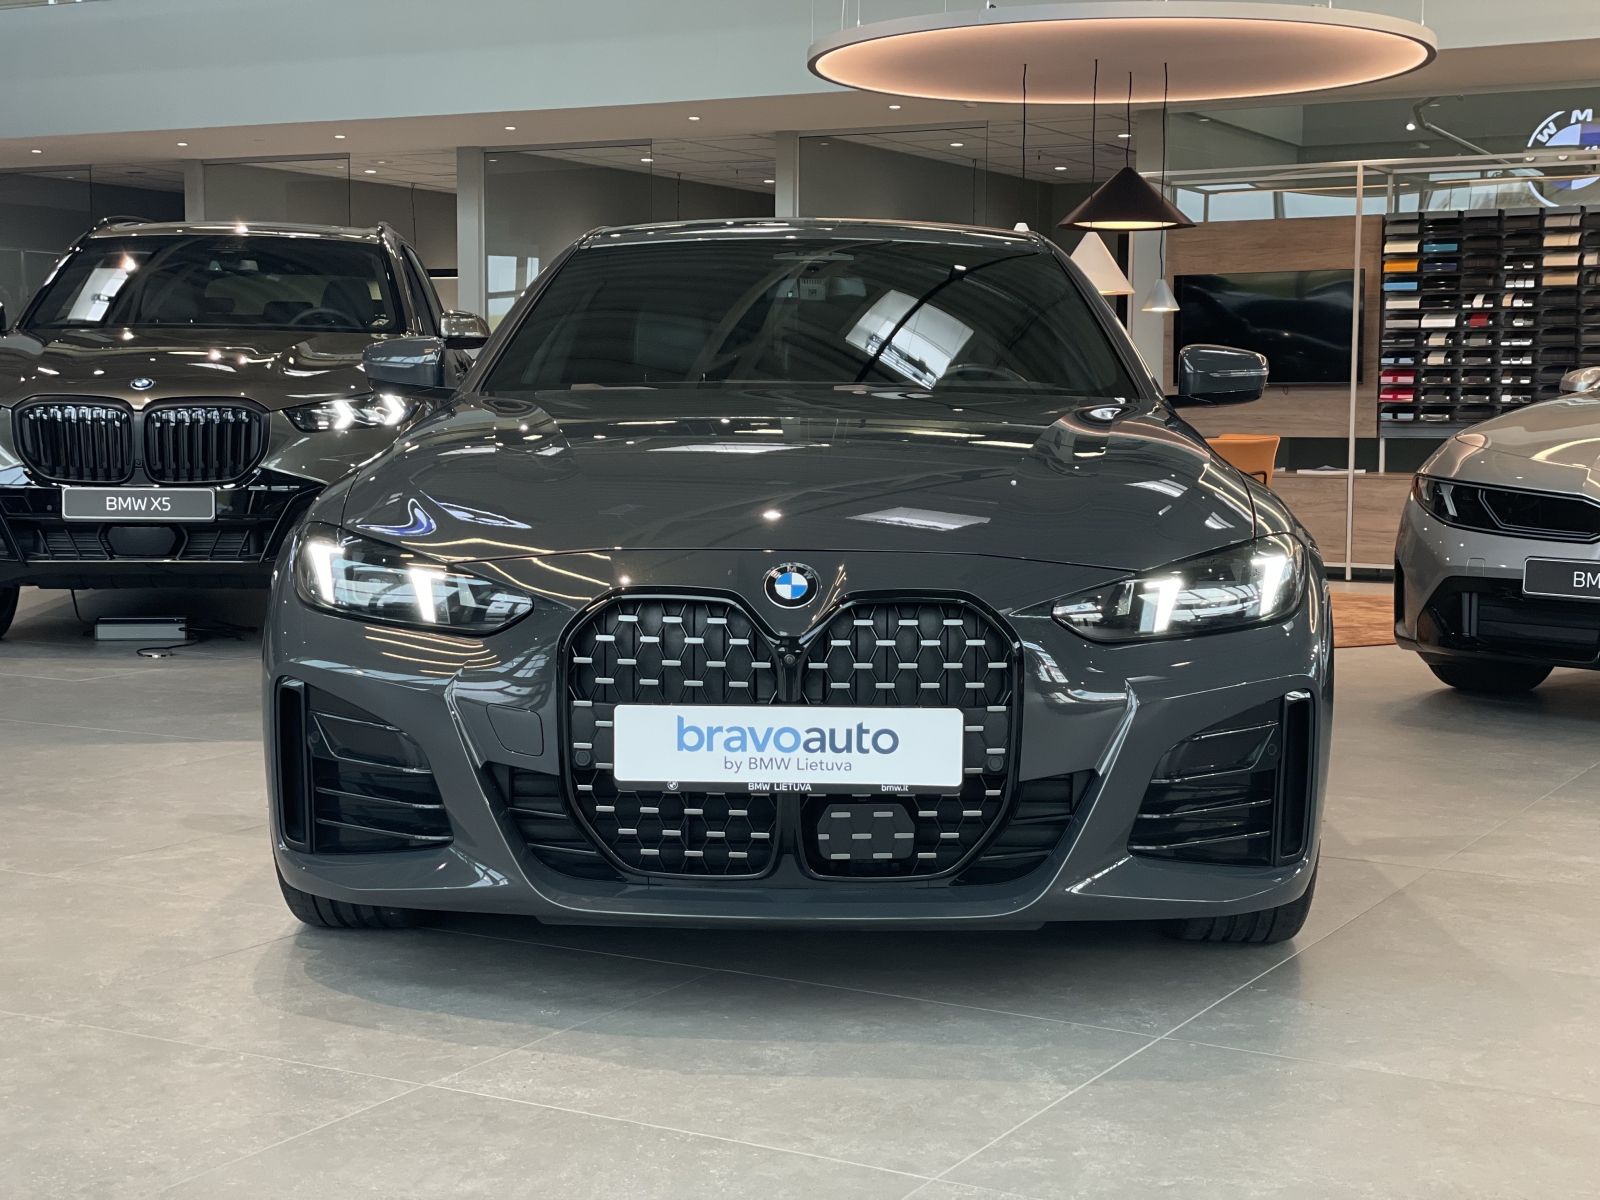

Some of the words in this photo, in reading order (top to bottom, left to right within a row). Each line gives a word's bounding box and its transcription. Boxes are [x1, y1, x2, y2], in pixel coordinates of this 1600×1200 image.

[105, 496, 148, 511] BMW
[150, 496, 171, 511] X5
[770, 565, 814, 580] BMW
[1573, 571, 1600, 588] BM
[677, 715, 899, 755] bravoauto
[724, 756, 743, 773] by
[749, 757, 791, 771] BMW
[797, 758, 852, 771] Lietuva
[748, 782, 771, 791] BMW
[774, 783, 812, 791] LIETUVA
